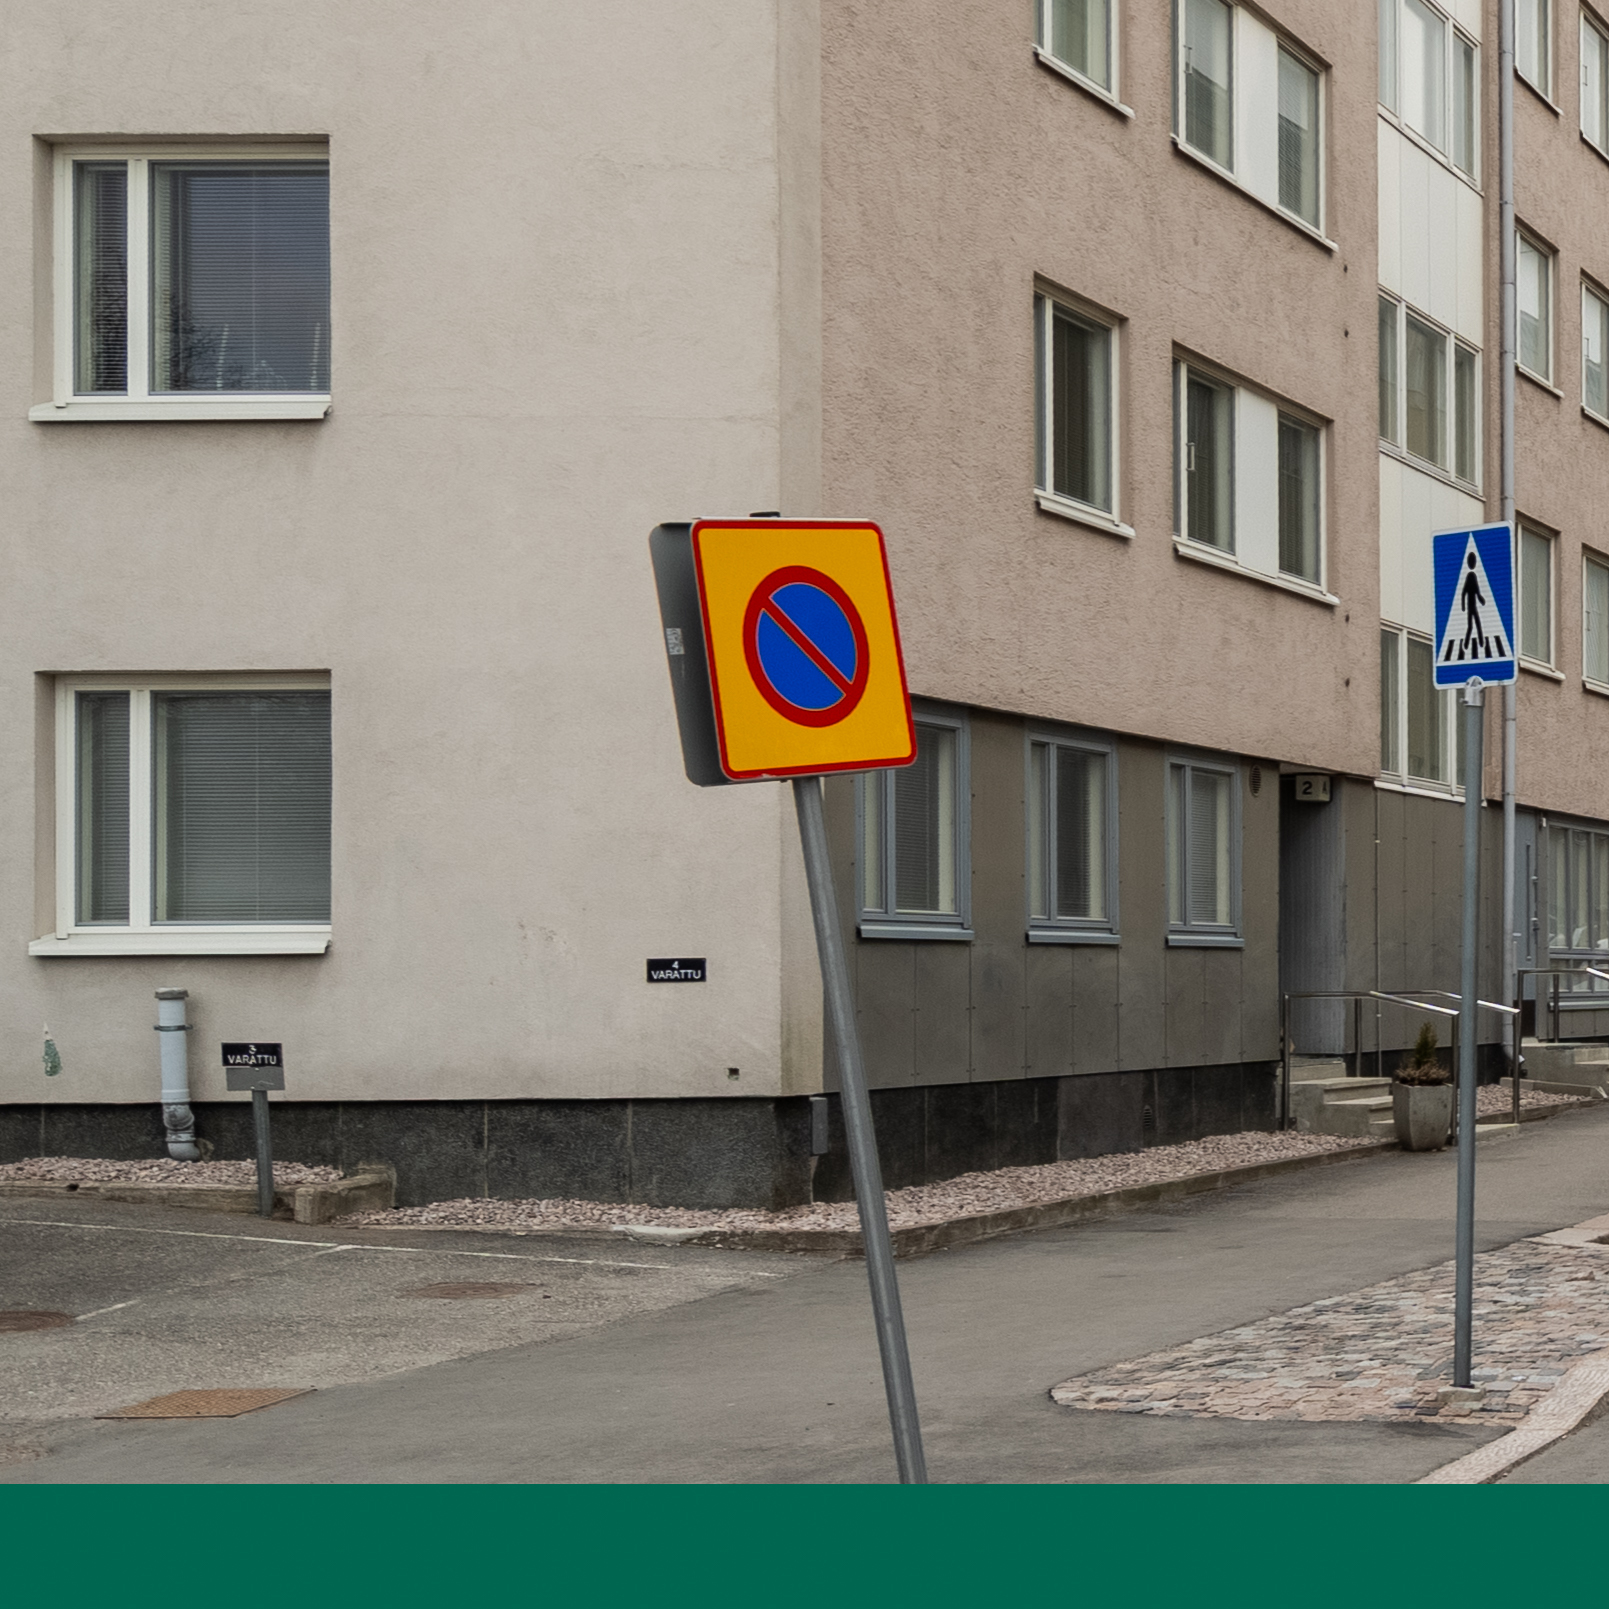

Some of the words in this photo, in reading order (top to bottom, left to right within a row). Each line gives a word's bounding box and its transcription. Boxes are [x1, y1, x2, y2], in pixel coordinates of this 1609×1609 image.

[1302, 780, 1313, 795] 2
[672, 960, 679, 969] 4
[651, 969, 701, 980] VARATTU
[249, 1044, 257, 1054] 3
[227, 1054, 277, 1065] VARATTU
